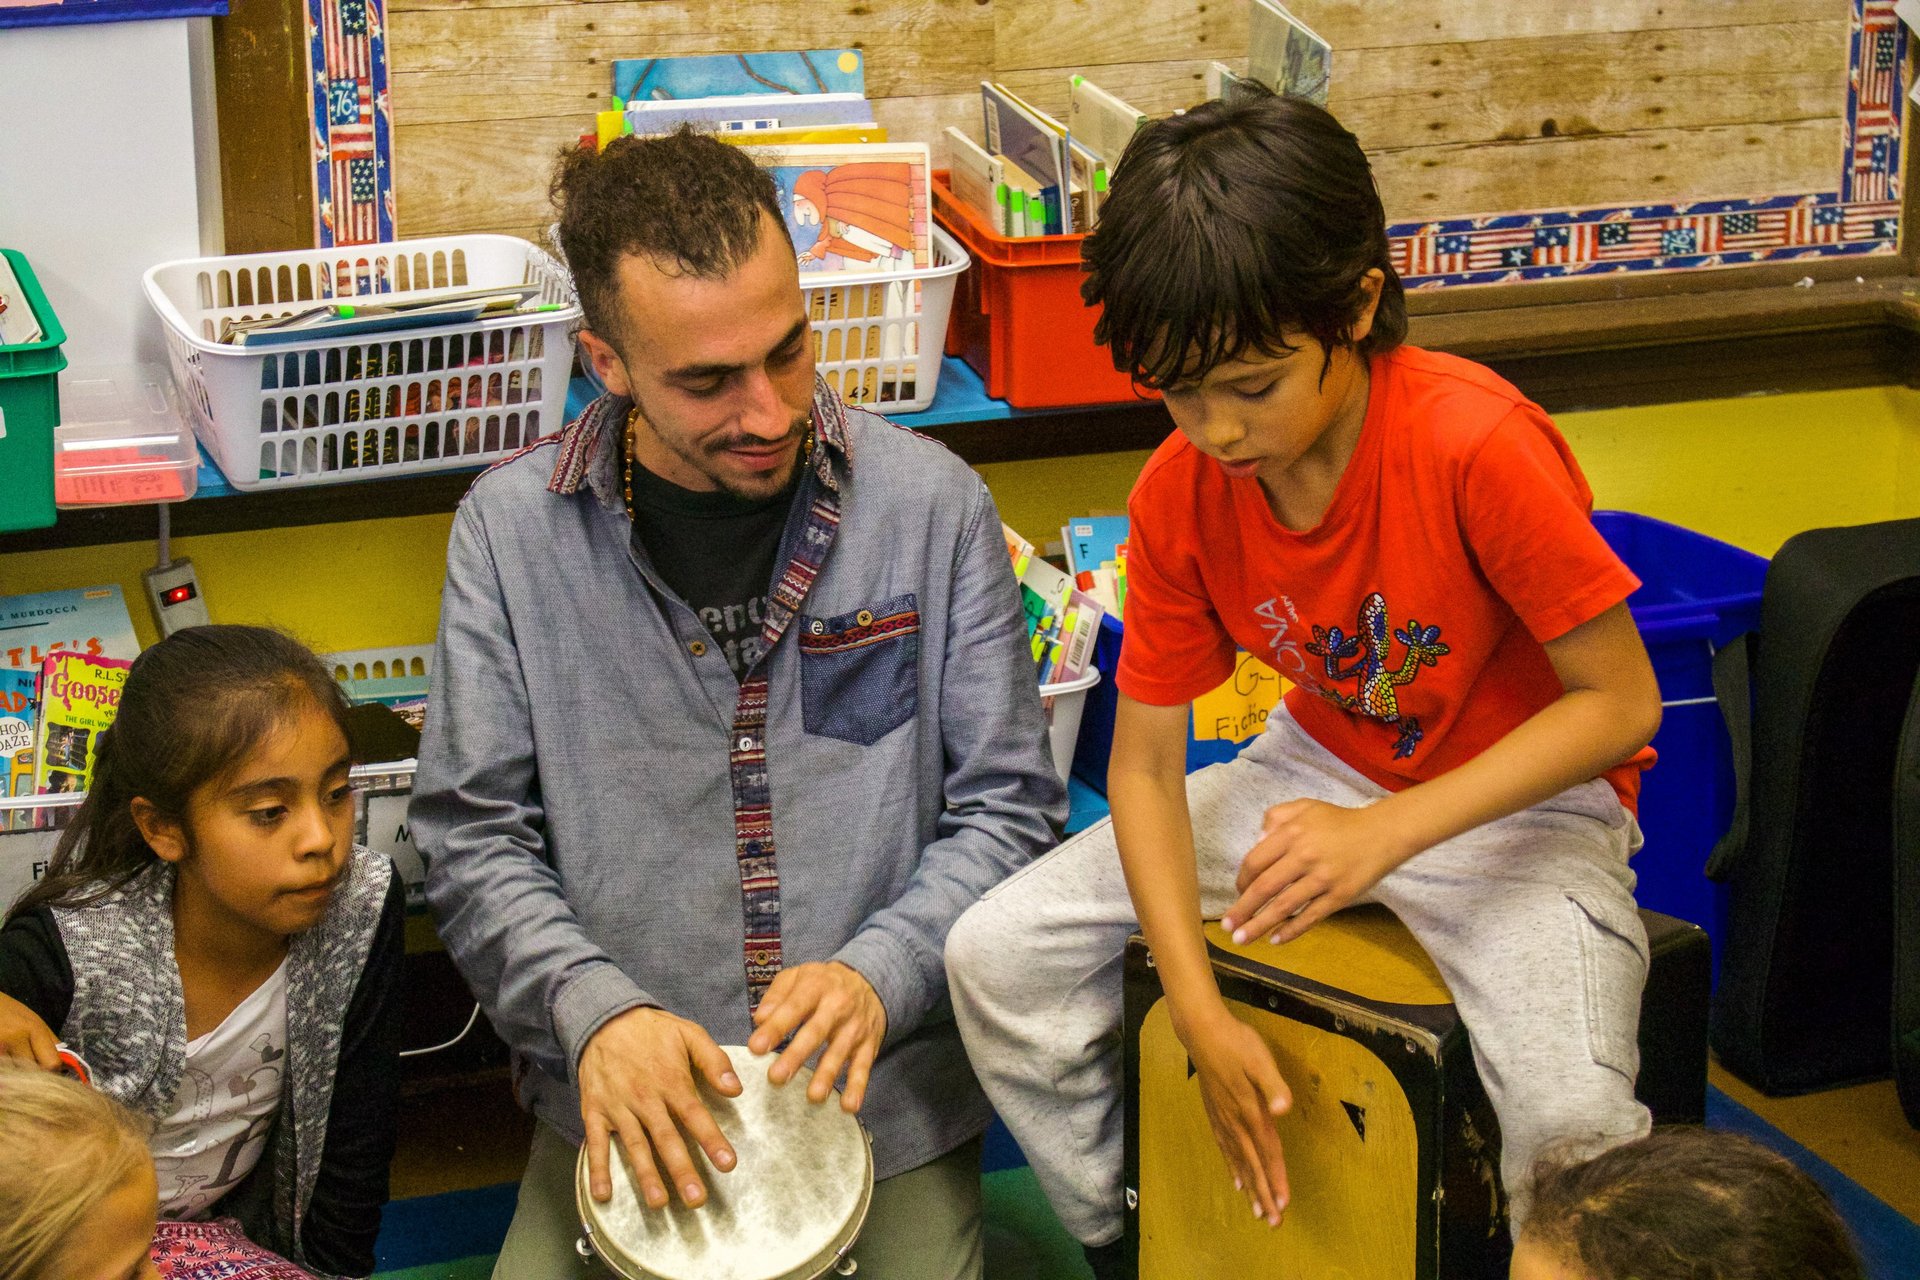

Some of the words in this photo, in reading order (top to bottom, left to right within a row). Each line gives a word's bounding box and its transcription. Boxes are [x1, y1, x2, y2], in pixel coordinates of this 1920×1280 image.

[334, 89, 353, 118] 76
[1079, 543, 1088, 559] F
[10, 605, 78, 619] MURDOCCA
[65, 715, 77, 723] THE
[79, 717, 95, 727] GIRL
